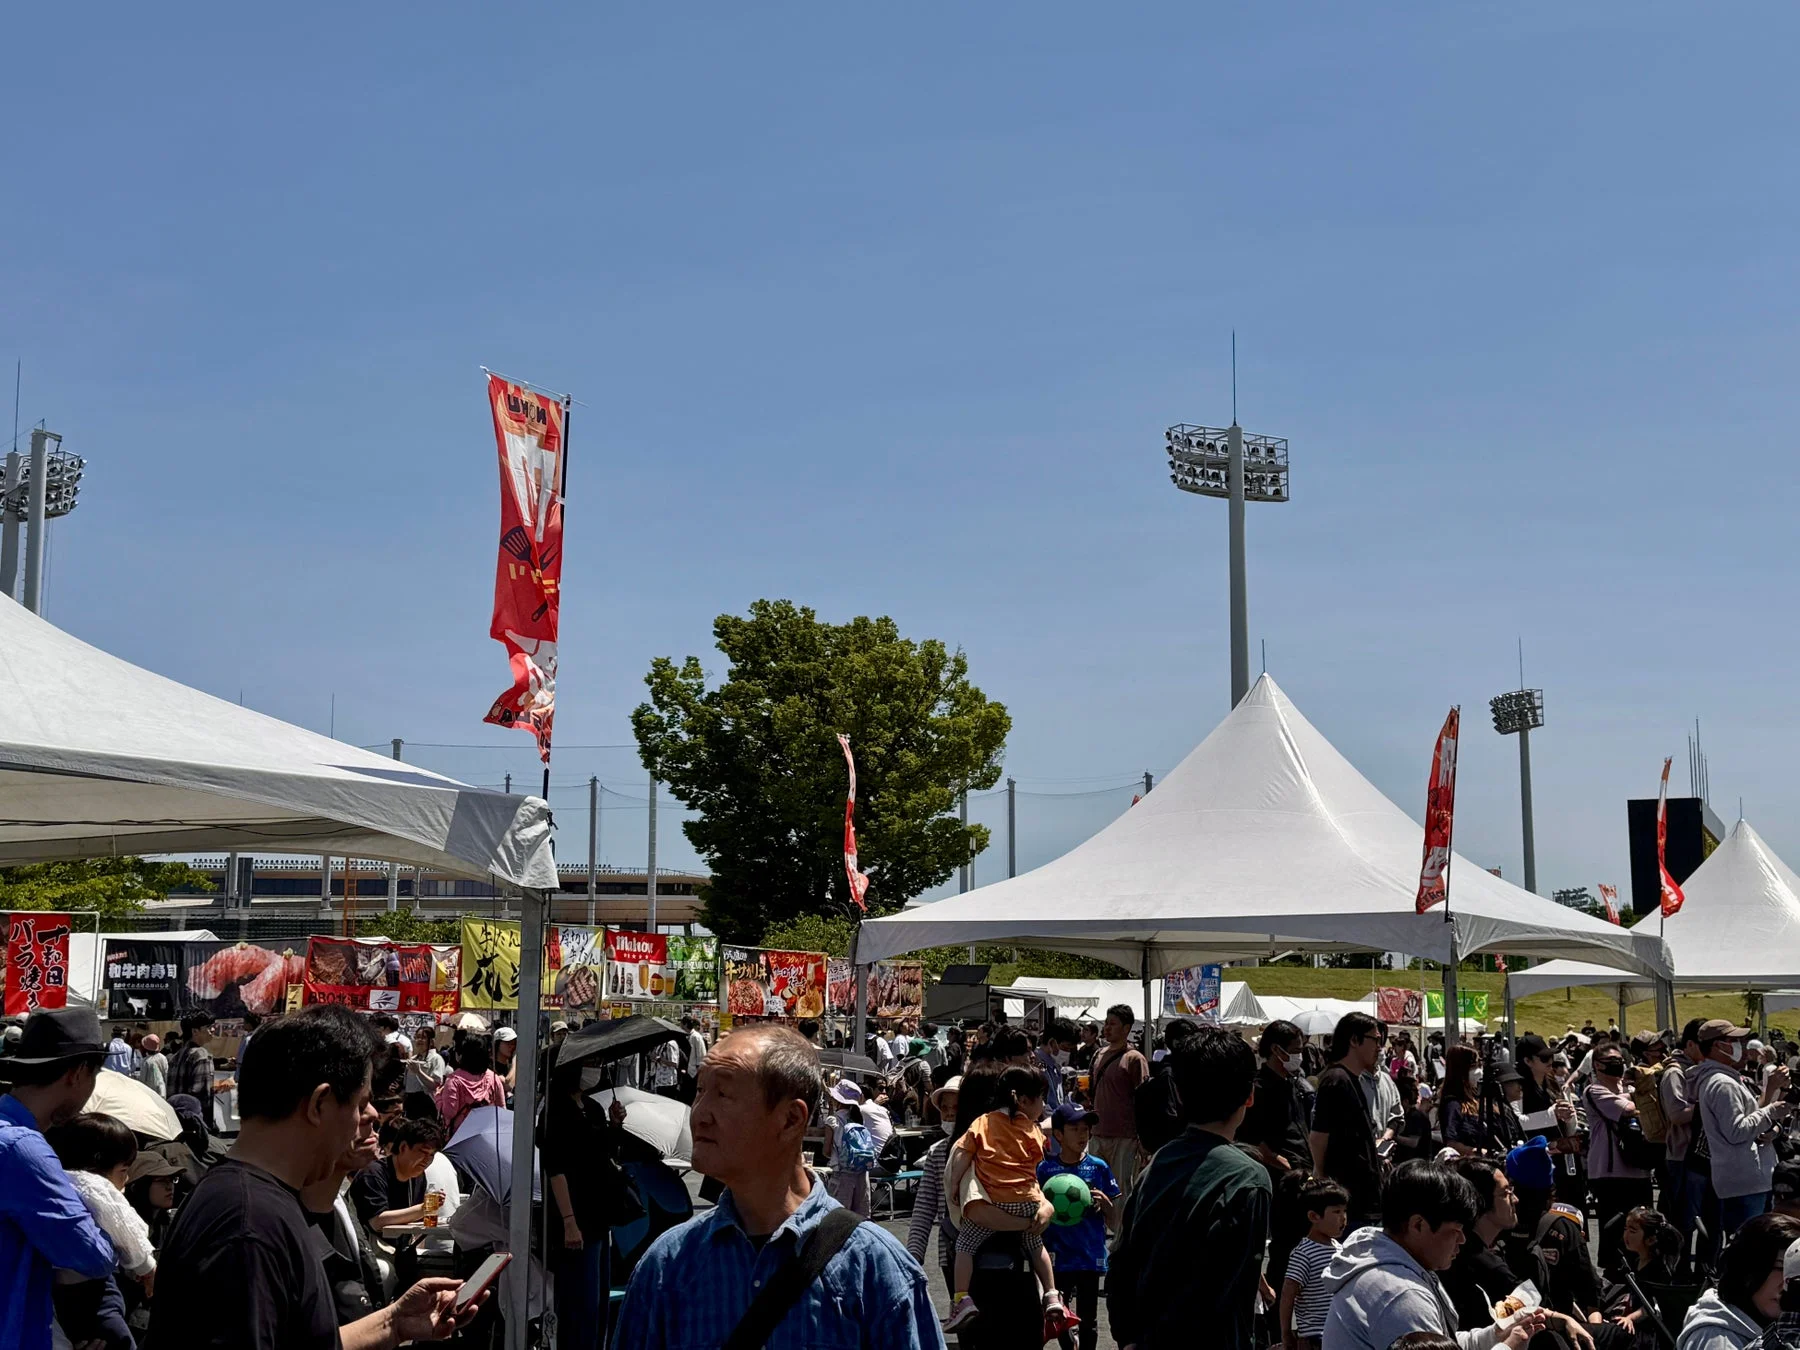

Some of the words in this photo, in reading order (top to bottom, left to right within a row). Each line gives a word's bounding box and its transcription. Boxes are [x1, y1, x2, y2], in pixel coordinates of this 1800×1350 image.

[479, 921, 520, 948] 牛たん
[560, 928, 589, 948] 厚切り
[36, 924, 70, 987] 十和田
[108, 963, 177, 979] 和牛肉寿司
